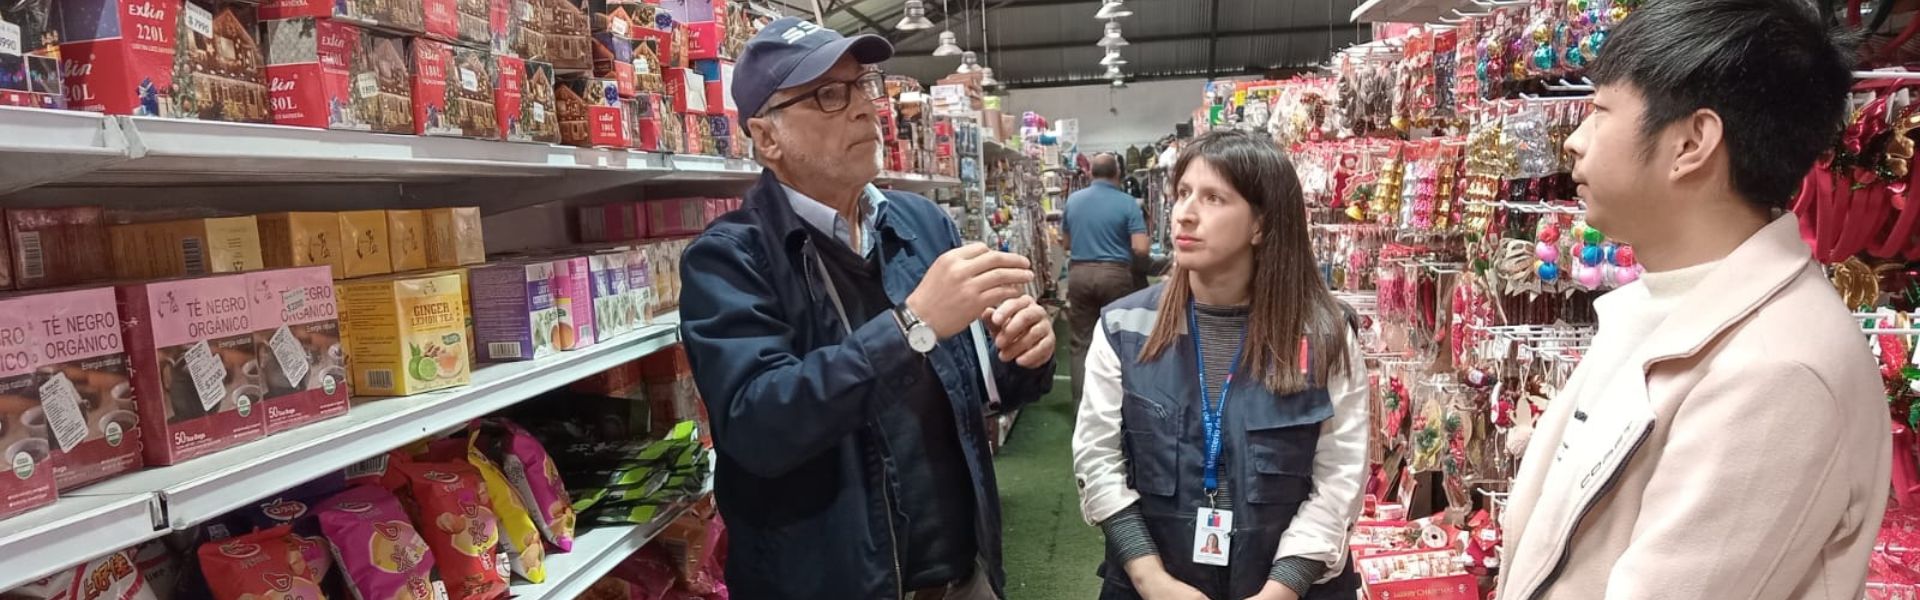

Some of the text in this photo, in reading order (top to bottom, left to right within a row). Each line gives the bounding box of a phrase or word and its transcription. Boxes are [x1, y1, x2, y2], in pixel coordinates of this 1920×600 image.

[136, 24, 169, 43] 220L
[206, 296, 246, 315] NEGRO
[413, 302, 450, 317] GINGER
[42, 311, 115, 336] TÉ NEGRO
[45, 333, 118, 360] ORGÁNICO
[268, 406, 278, 417] 50
[174, 432, 185, 446] 50
[1205, 430, 1220, 469] Ministerio
